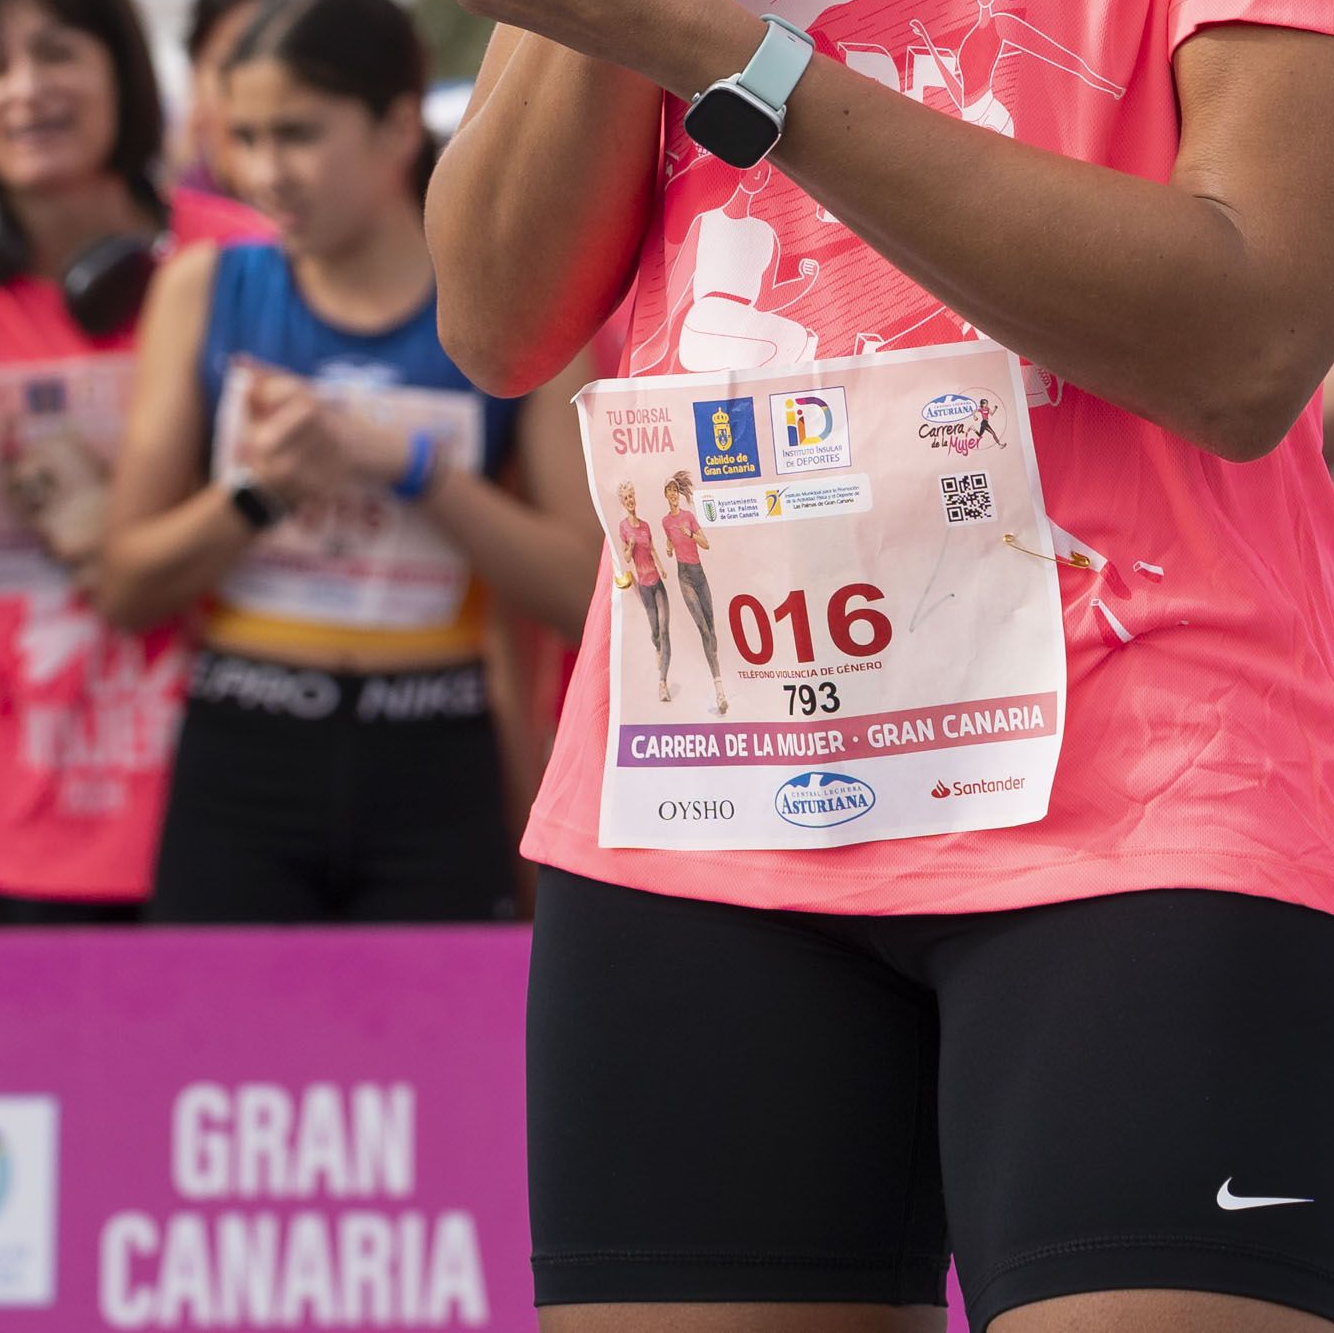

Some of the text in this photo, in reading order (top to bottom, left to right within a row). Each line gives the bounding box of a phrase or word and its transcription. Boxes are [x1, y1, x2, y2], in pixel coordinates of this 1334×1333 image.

[606, 407, 672, 426] TU DORSAL
[927, 405, 974, 418] ASTURIANA
[612, 426, 675, 455] SUMA
[919, 423, 965, 438] Carrera
[931, 432, 983, 456] de la Mujer
[705, 452, 748, 466] Cabildo de
[797, 453, 840, 466] DEPORTES
[704, 463, 755, 476] Gran Canaria
[729, 583, 893, 665] 016
[738, 661, 882, 679] TELÉFONO VIOLENCIA DE GÉNERO
[783, 681, 840, 716] 793
[631, 705, 1045, 759] CARRERA DE LA MUJER GRAN CANARIA
[823, 785, 863, 795] LECHERA
[953, 776, 1026, 796] Santander
[658, 799, 735, 822] OYSHO
[782, 793, 869, 814] ASTURIANA
[174, 1083, 415, 1197] GRAN
[100, 1211, 488, 1327] CANARIA
